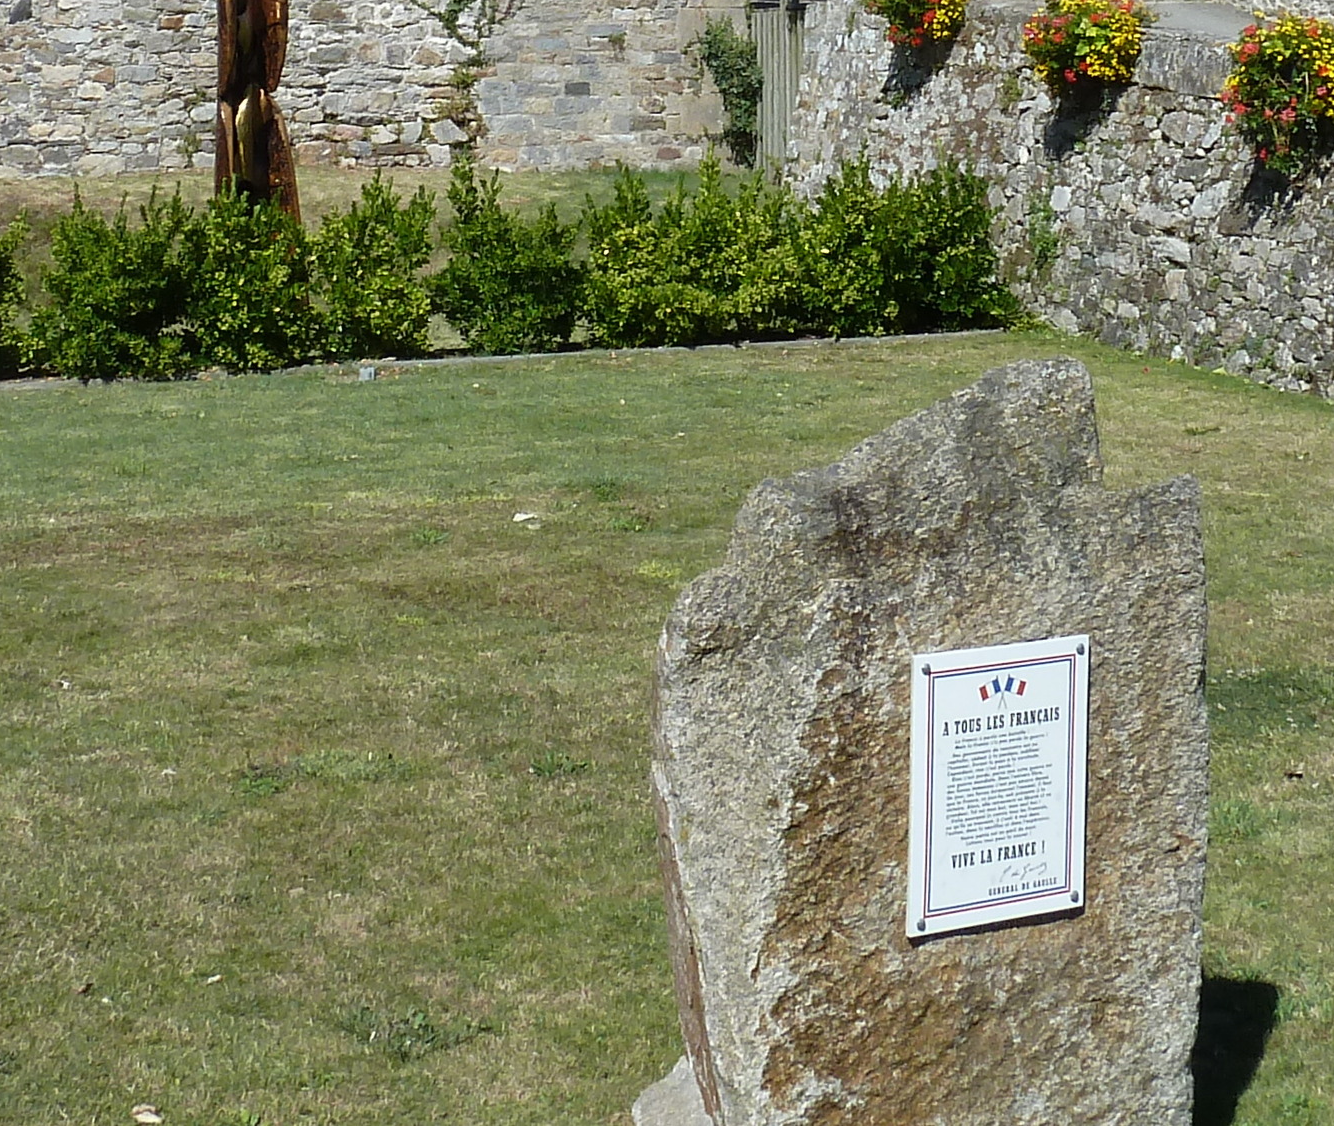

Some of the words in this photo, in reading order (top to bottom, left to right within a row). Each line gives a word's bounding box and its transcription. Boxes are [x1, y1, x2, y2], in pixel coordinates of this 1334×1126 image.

[954, 718, 981, 735] TOUS
[987, 715, 1005, 730] LES
[1010, 707, 1059, 728] FRANÇAIS
[951, 852, 975, 869] VIVE
[980, 849, 992, 864] LA
[998, 842, 1036, 861] FRANCE
[1022, 881, 1030, 890] DE
[1033, 877, 1057, 888] GAULLE
